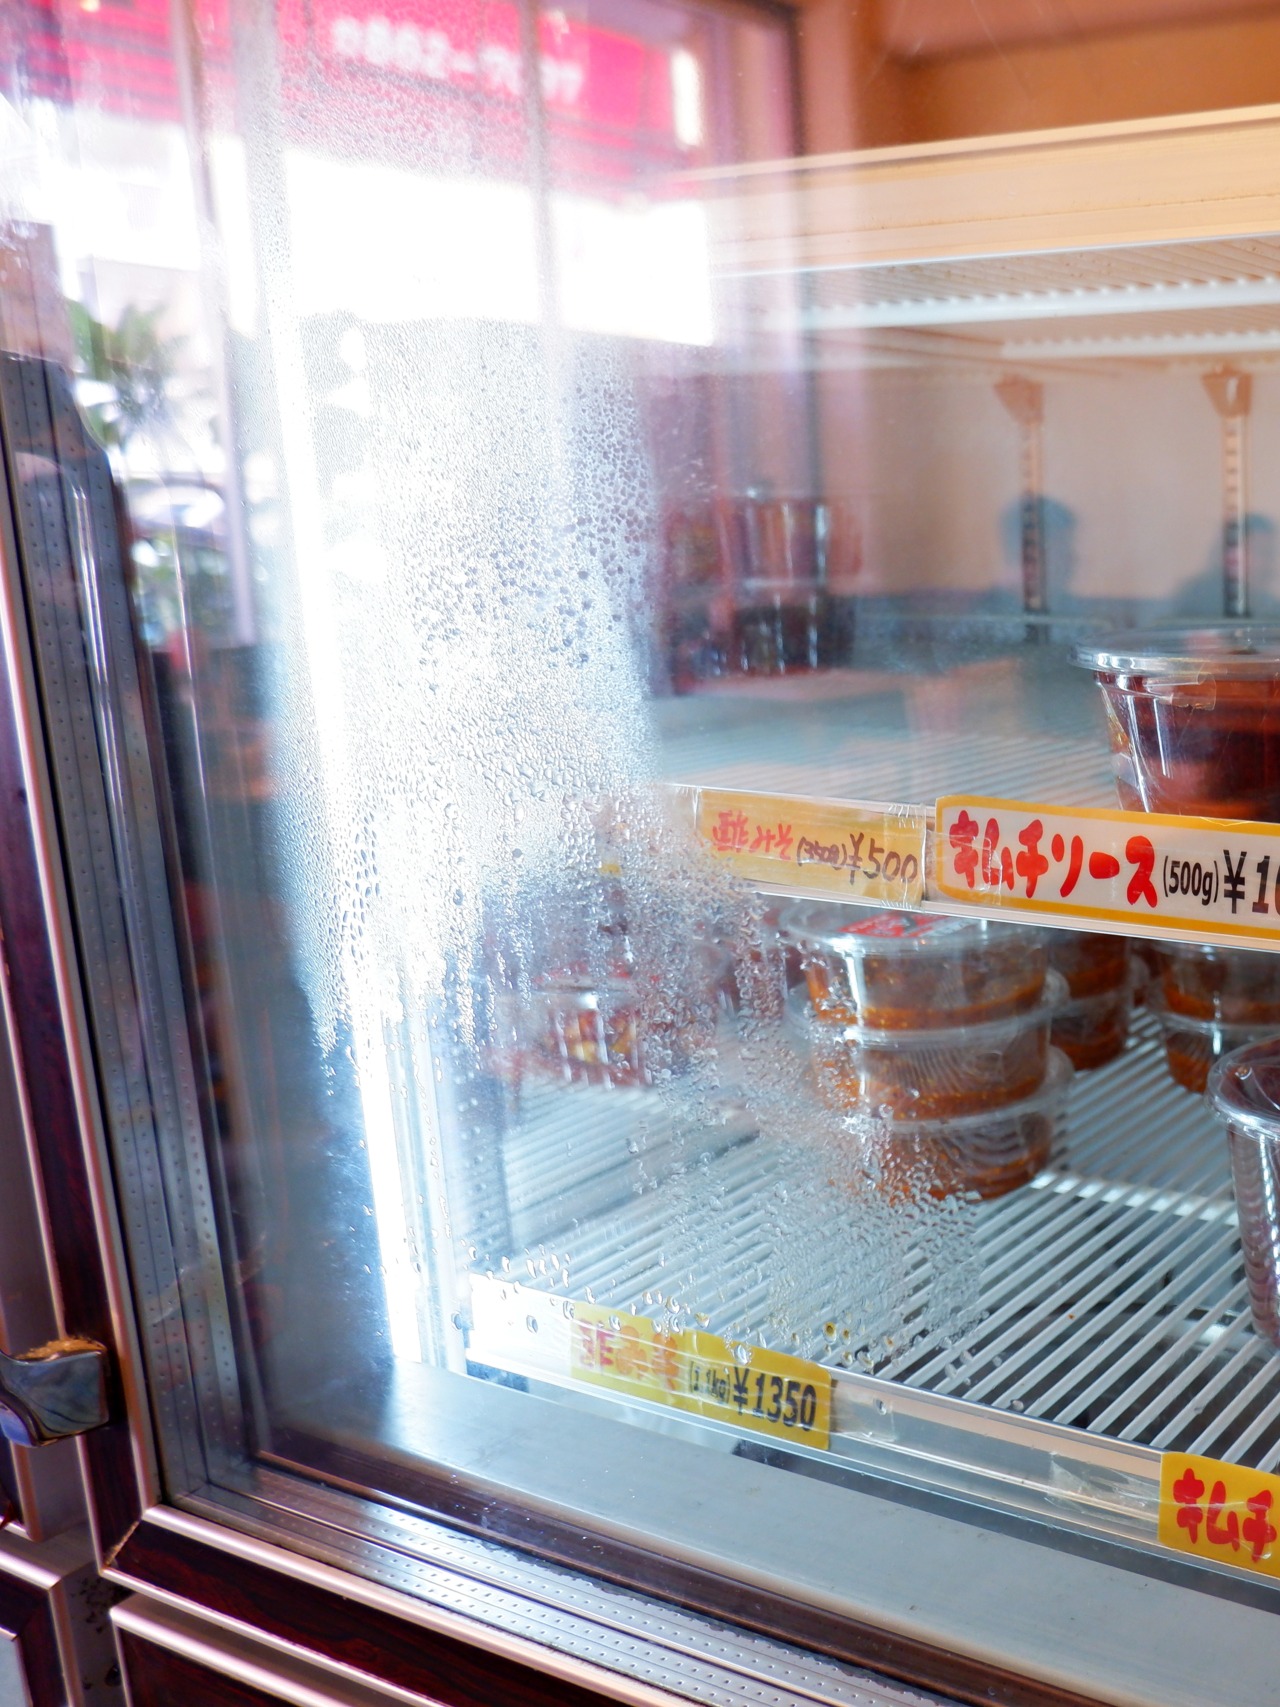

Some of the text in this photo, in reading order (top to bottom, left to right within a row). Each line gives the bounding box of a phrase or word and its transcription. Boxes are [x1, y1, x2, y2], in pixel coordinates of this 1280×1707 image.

[949, 809, 1158, 908] キムチソース
[1163, 854, 1218, 906] (500g)
[733, 1366, 816, 1432] ¥1350
